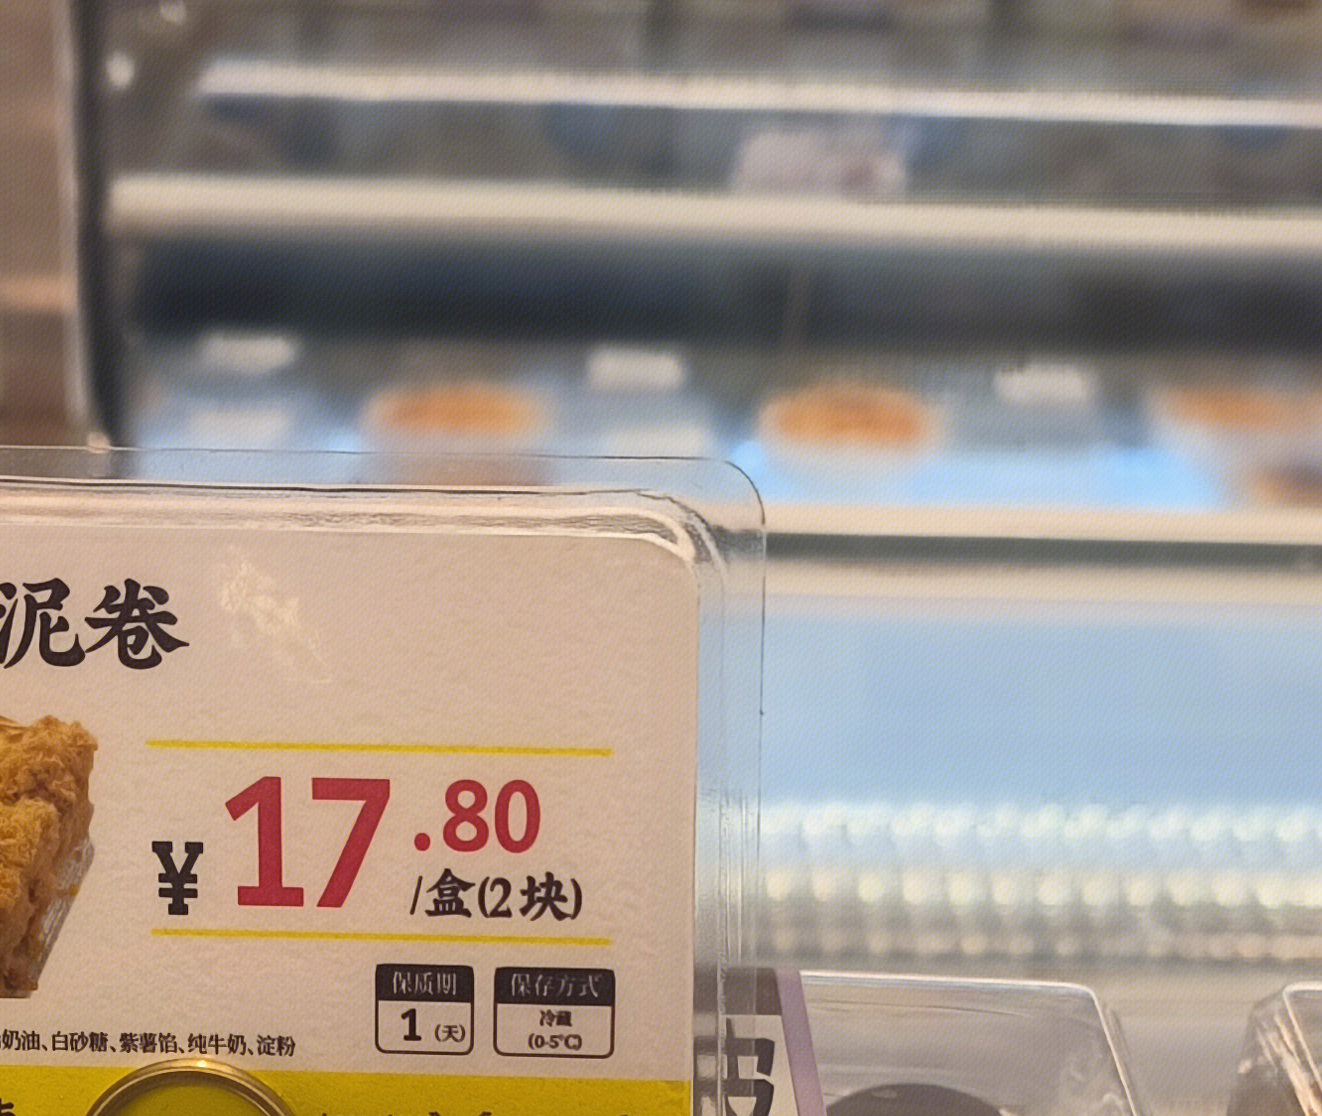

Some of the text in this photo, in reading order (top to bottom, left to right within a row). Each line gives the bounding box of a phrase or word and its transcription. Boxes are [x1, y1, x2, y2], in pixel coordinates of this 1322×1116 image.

[393, 971, 457, 996] 保质期
[511, 973, 605, 998] 保存方式
[539, 1009, 573, 1027] 冷藏
